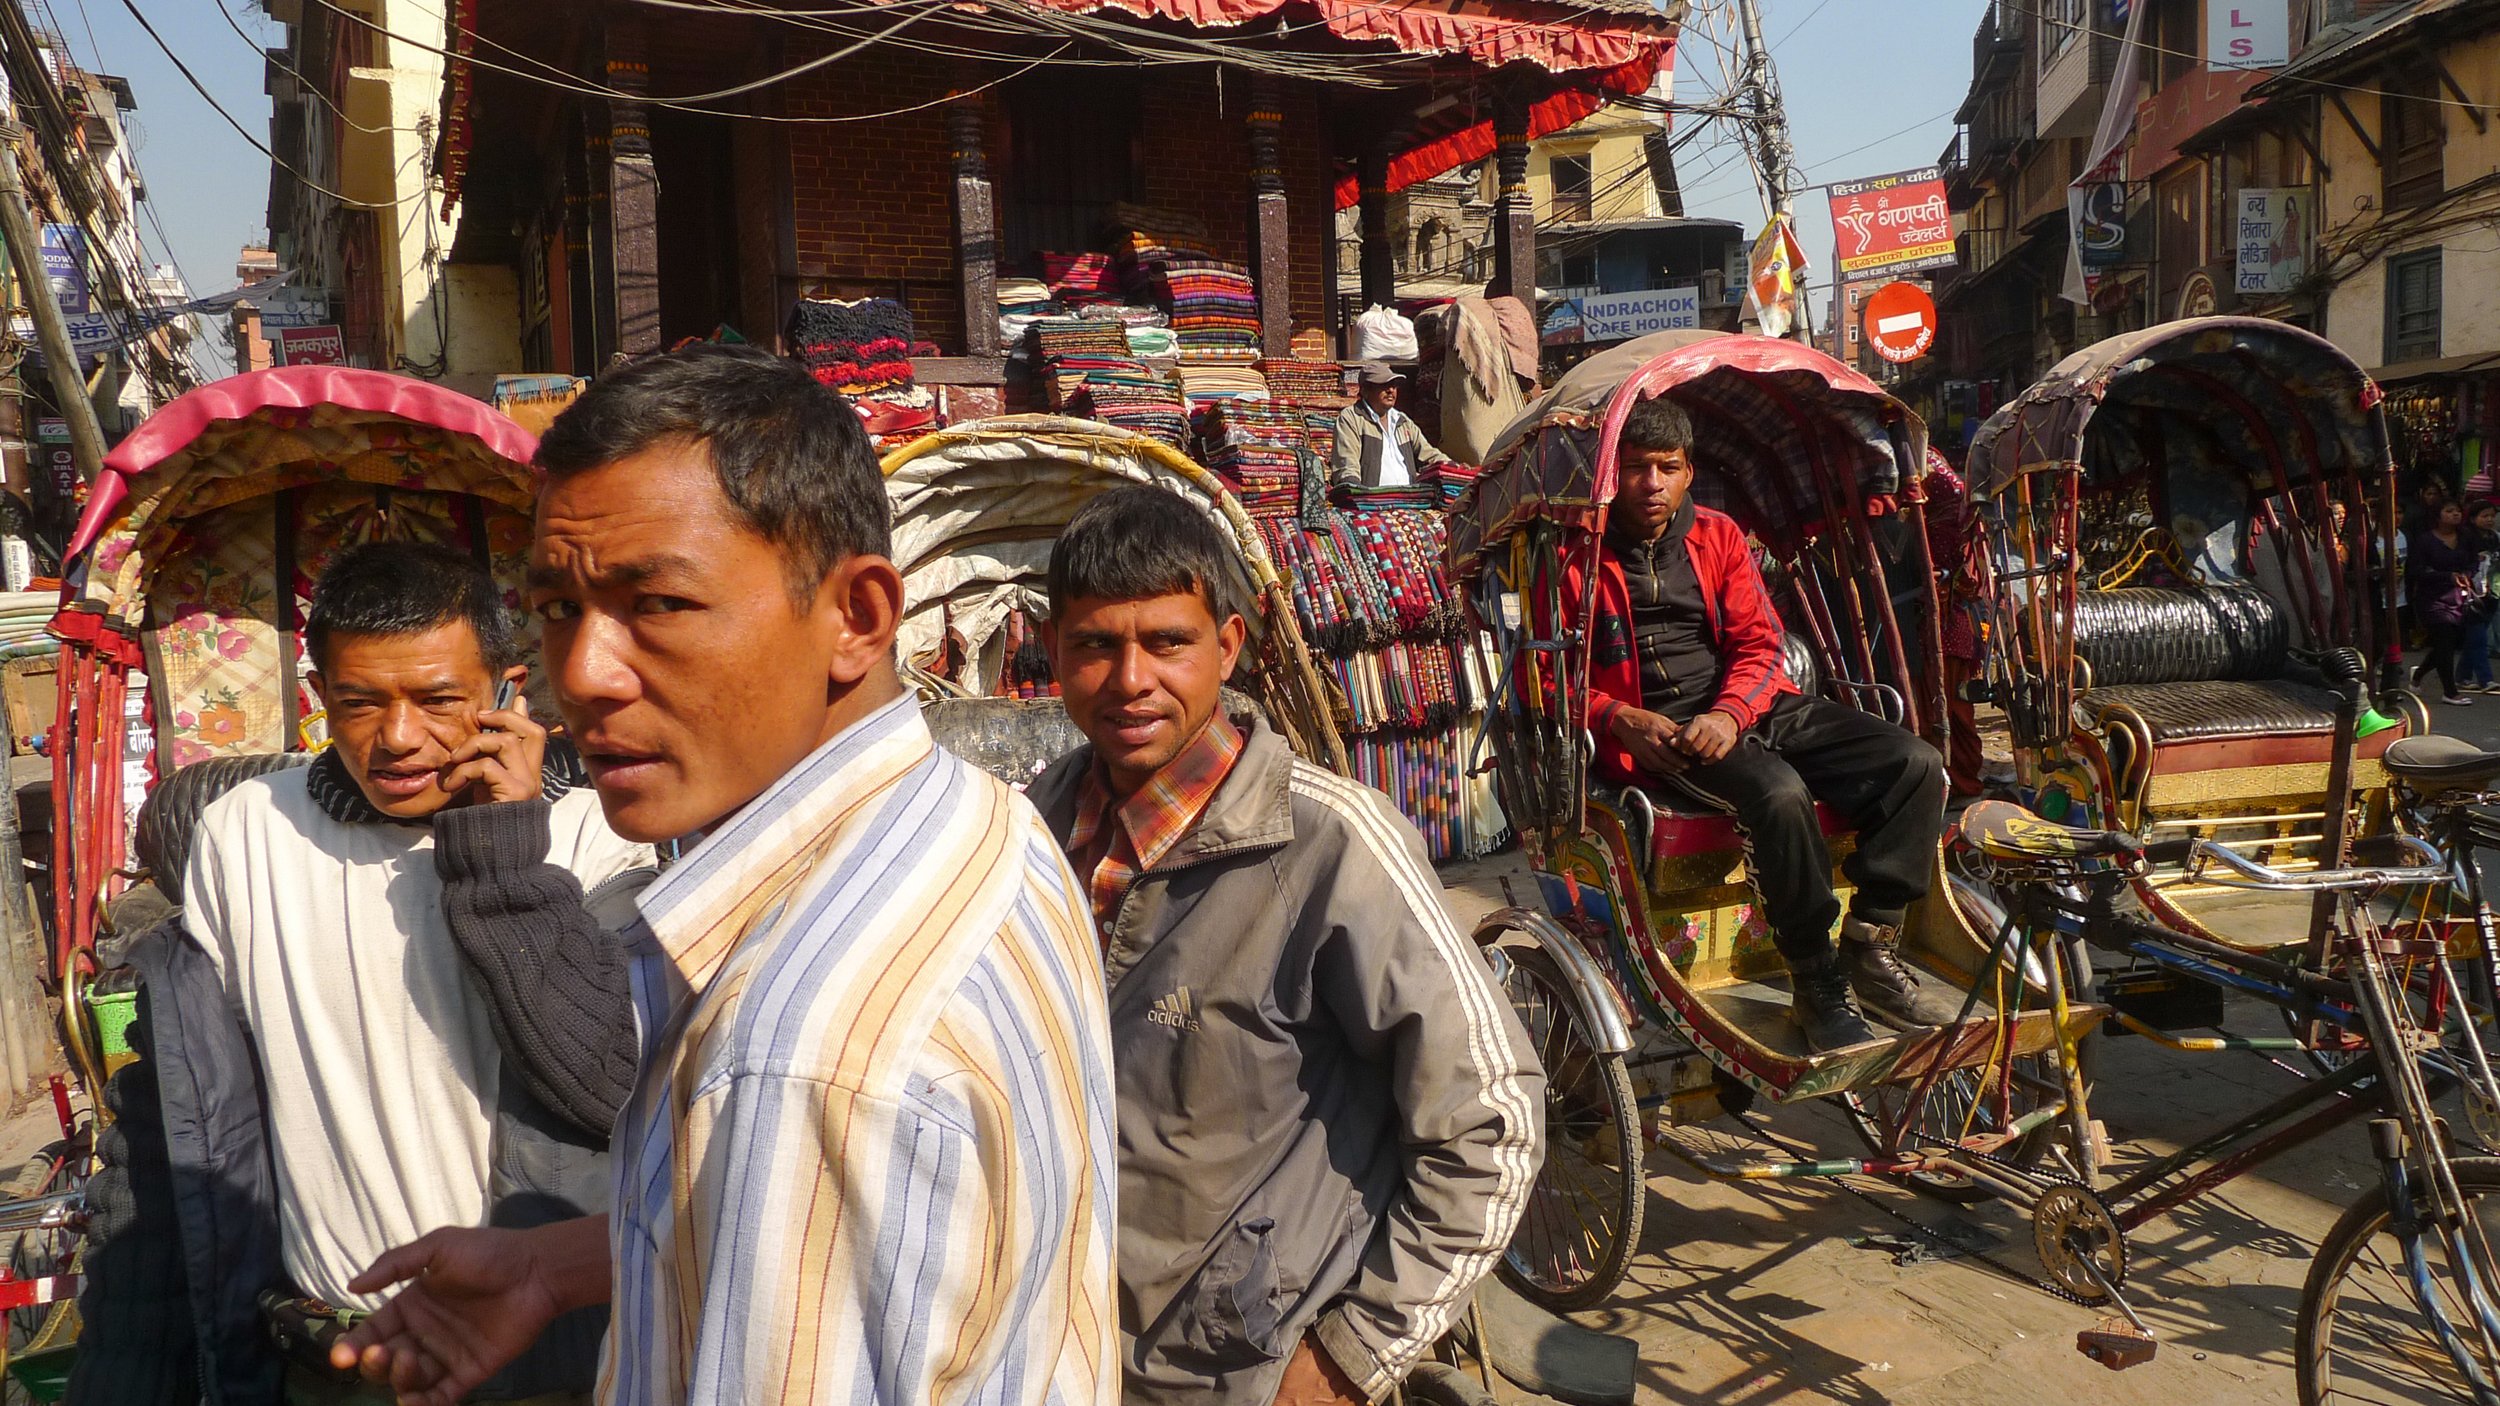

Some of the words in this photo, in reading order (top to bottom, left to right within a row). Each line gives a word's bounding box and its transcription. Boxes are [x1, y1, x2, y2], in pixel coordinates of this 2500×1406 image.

[1878, 194, 1947, 228] गणपती
[1586, 297, 1695, 319] INDRACHOK
[1543, 316, 1580, 329] EPSI
[1588, 320, 1631, 336] CAFE
[1636, 315, 1693, 332] HOUSE
[285, 335, 339, 358] जनकपुर
[1147, 1009, 1200, 1032] adidas
